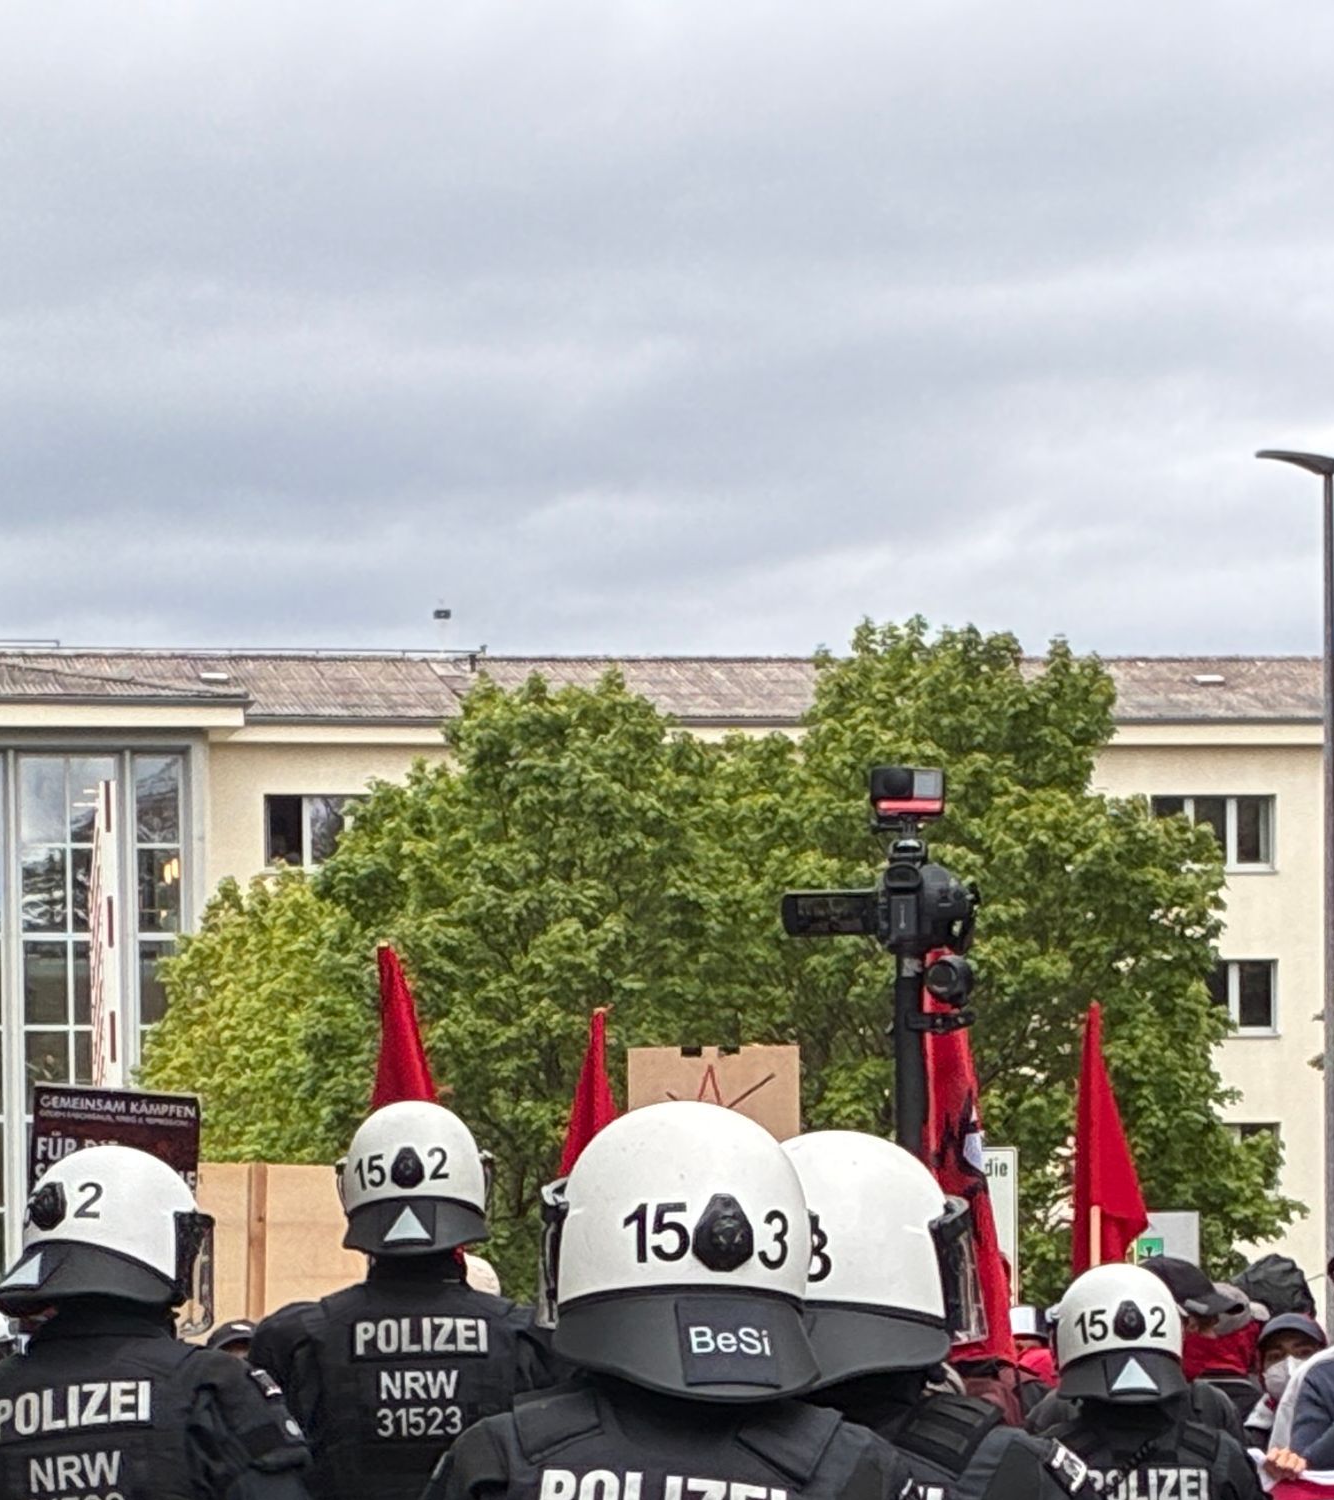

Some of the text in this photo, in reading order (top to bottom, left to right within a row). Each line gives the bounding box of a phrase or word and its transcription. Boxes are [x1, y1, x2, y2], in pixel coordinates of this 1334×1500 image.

[39, 1095, 126, 1113] GEMEINSAM
[130, 1099, 196, 1119] KÄMPFEN
[354, 1147, 450, 1191] 15 2
[73, 1182, 103, 1219] 2
[623, 1202, 789, 1270] 15 3
[355, 1316, 490, 1355] POLIZEI
[689, 1326, 772, 1357] BeSi
[1074, 1306, 1167, 1344] 15 2
[380, 1369, 459, 1400] NRW
[376, 1406, 463, 1438] 31523
[30, 1451, 121, 1493] NRW
